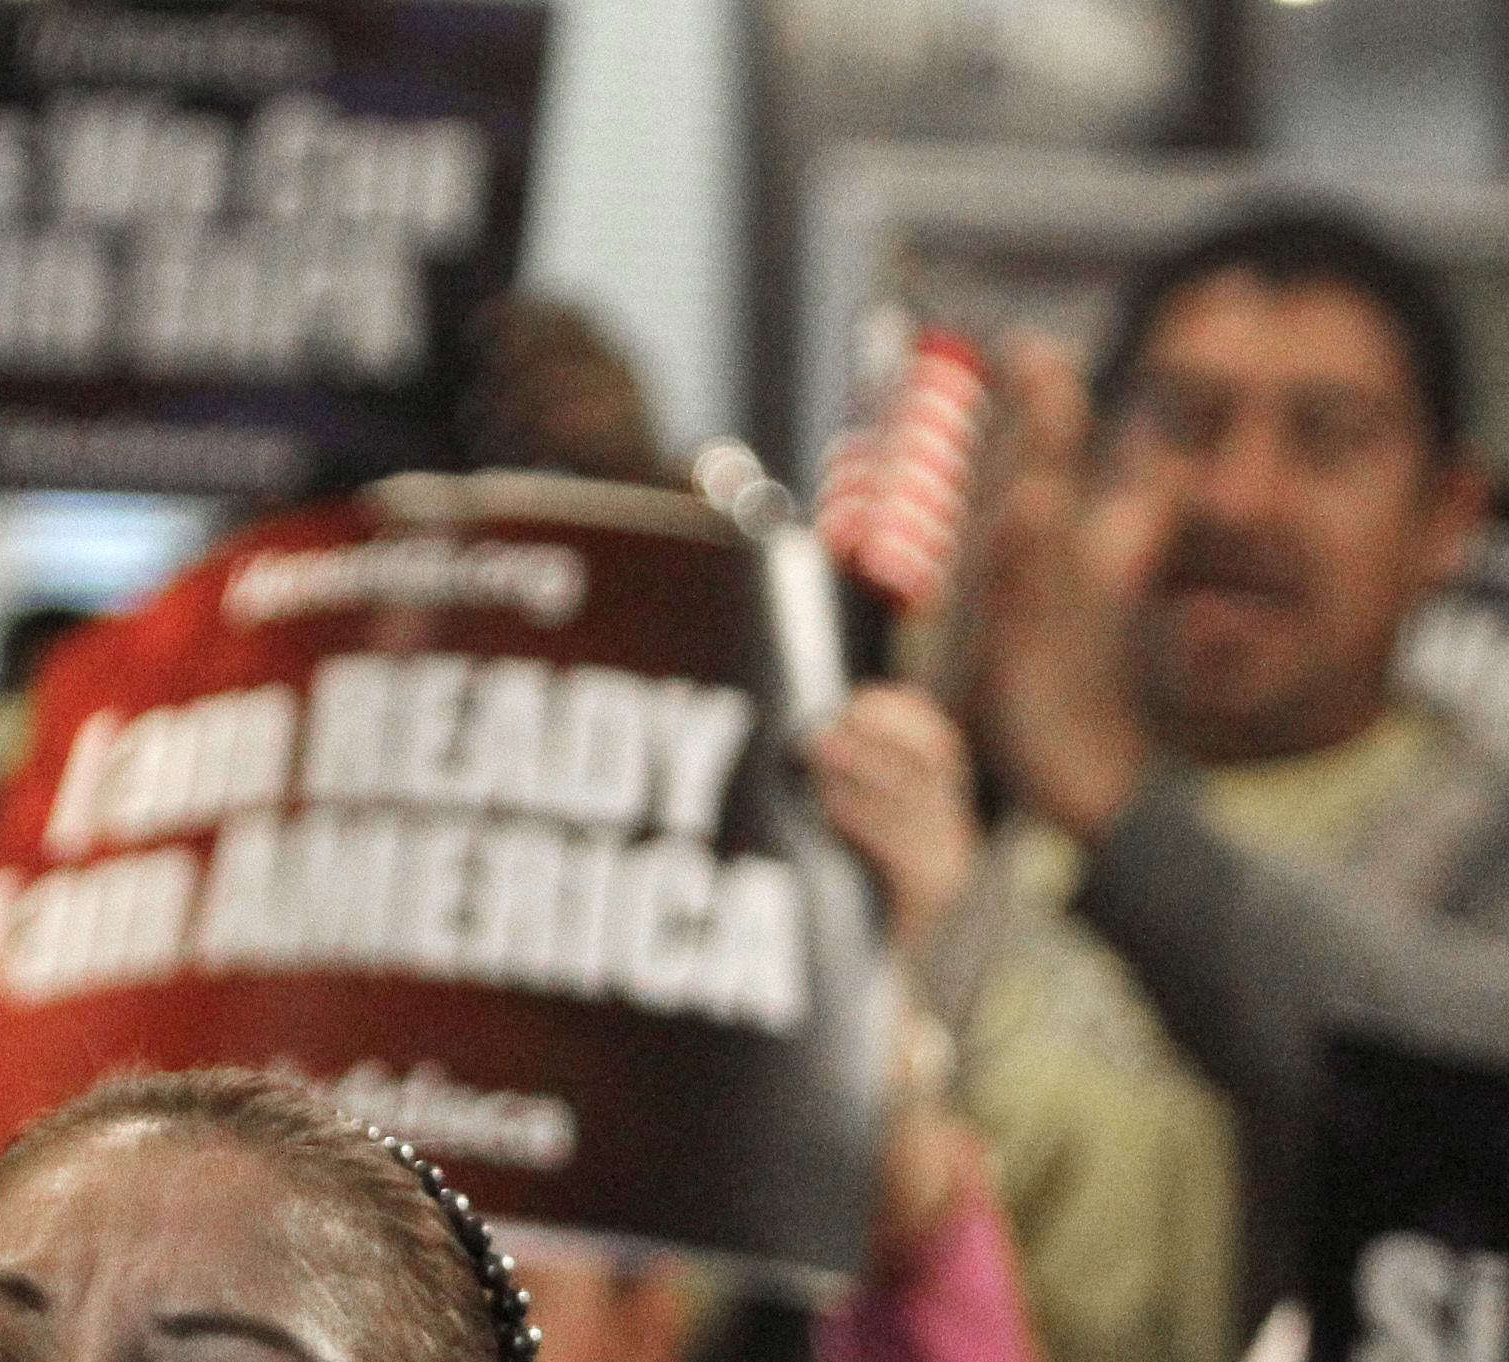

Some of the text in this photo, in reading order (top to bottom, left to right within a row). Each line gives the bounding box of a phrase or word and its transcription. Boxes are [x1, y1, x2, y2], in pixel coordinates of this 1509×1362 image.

[47, 90, 232, 225] We
[250, 94, 486, 250] Can
[45, 653, 754, 857] I am READY
[199, 806, 812, 1033] AMERICA
